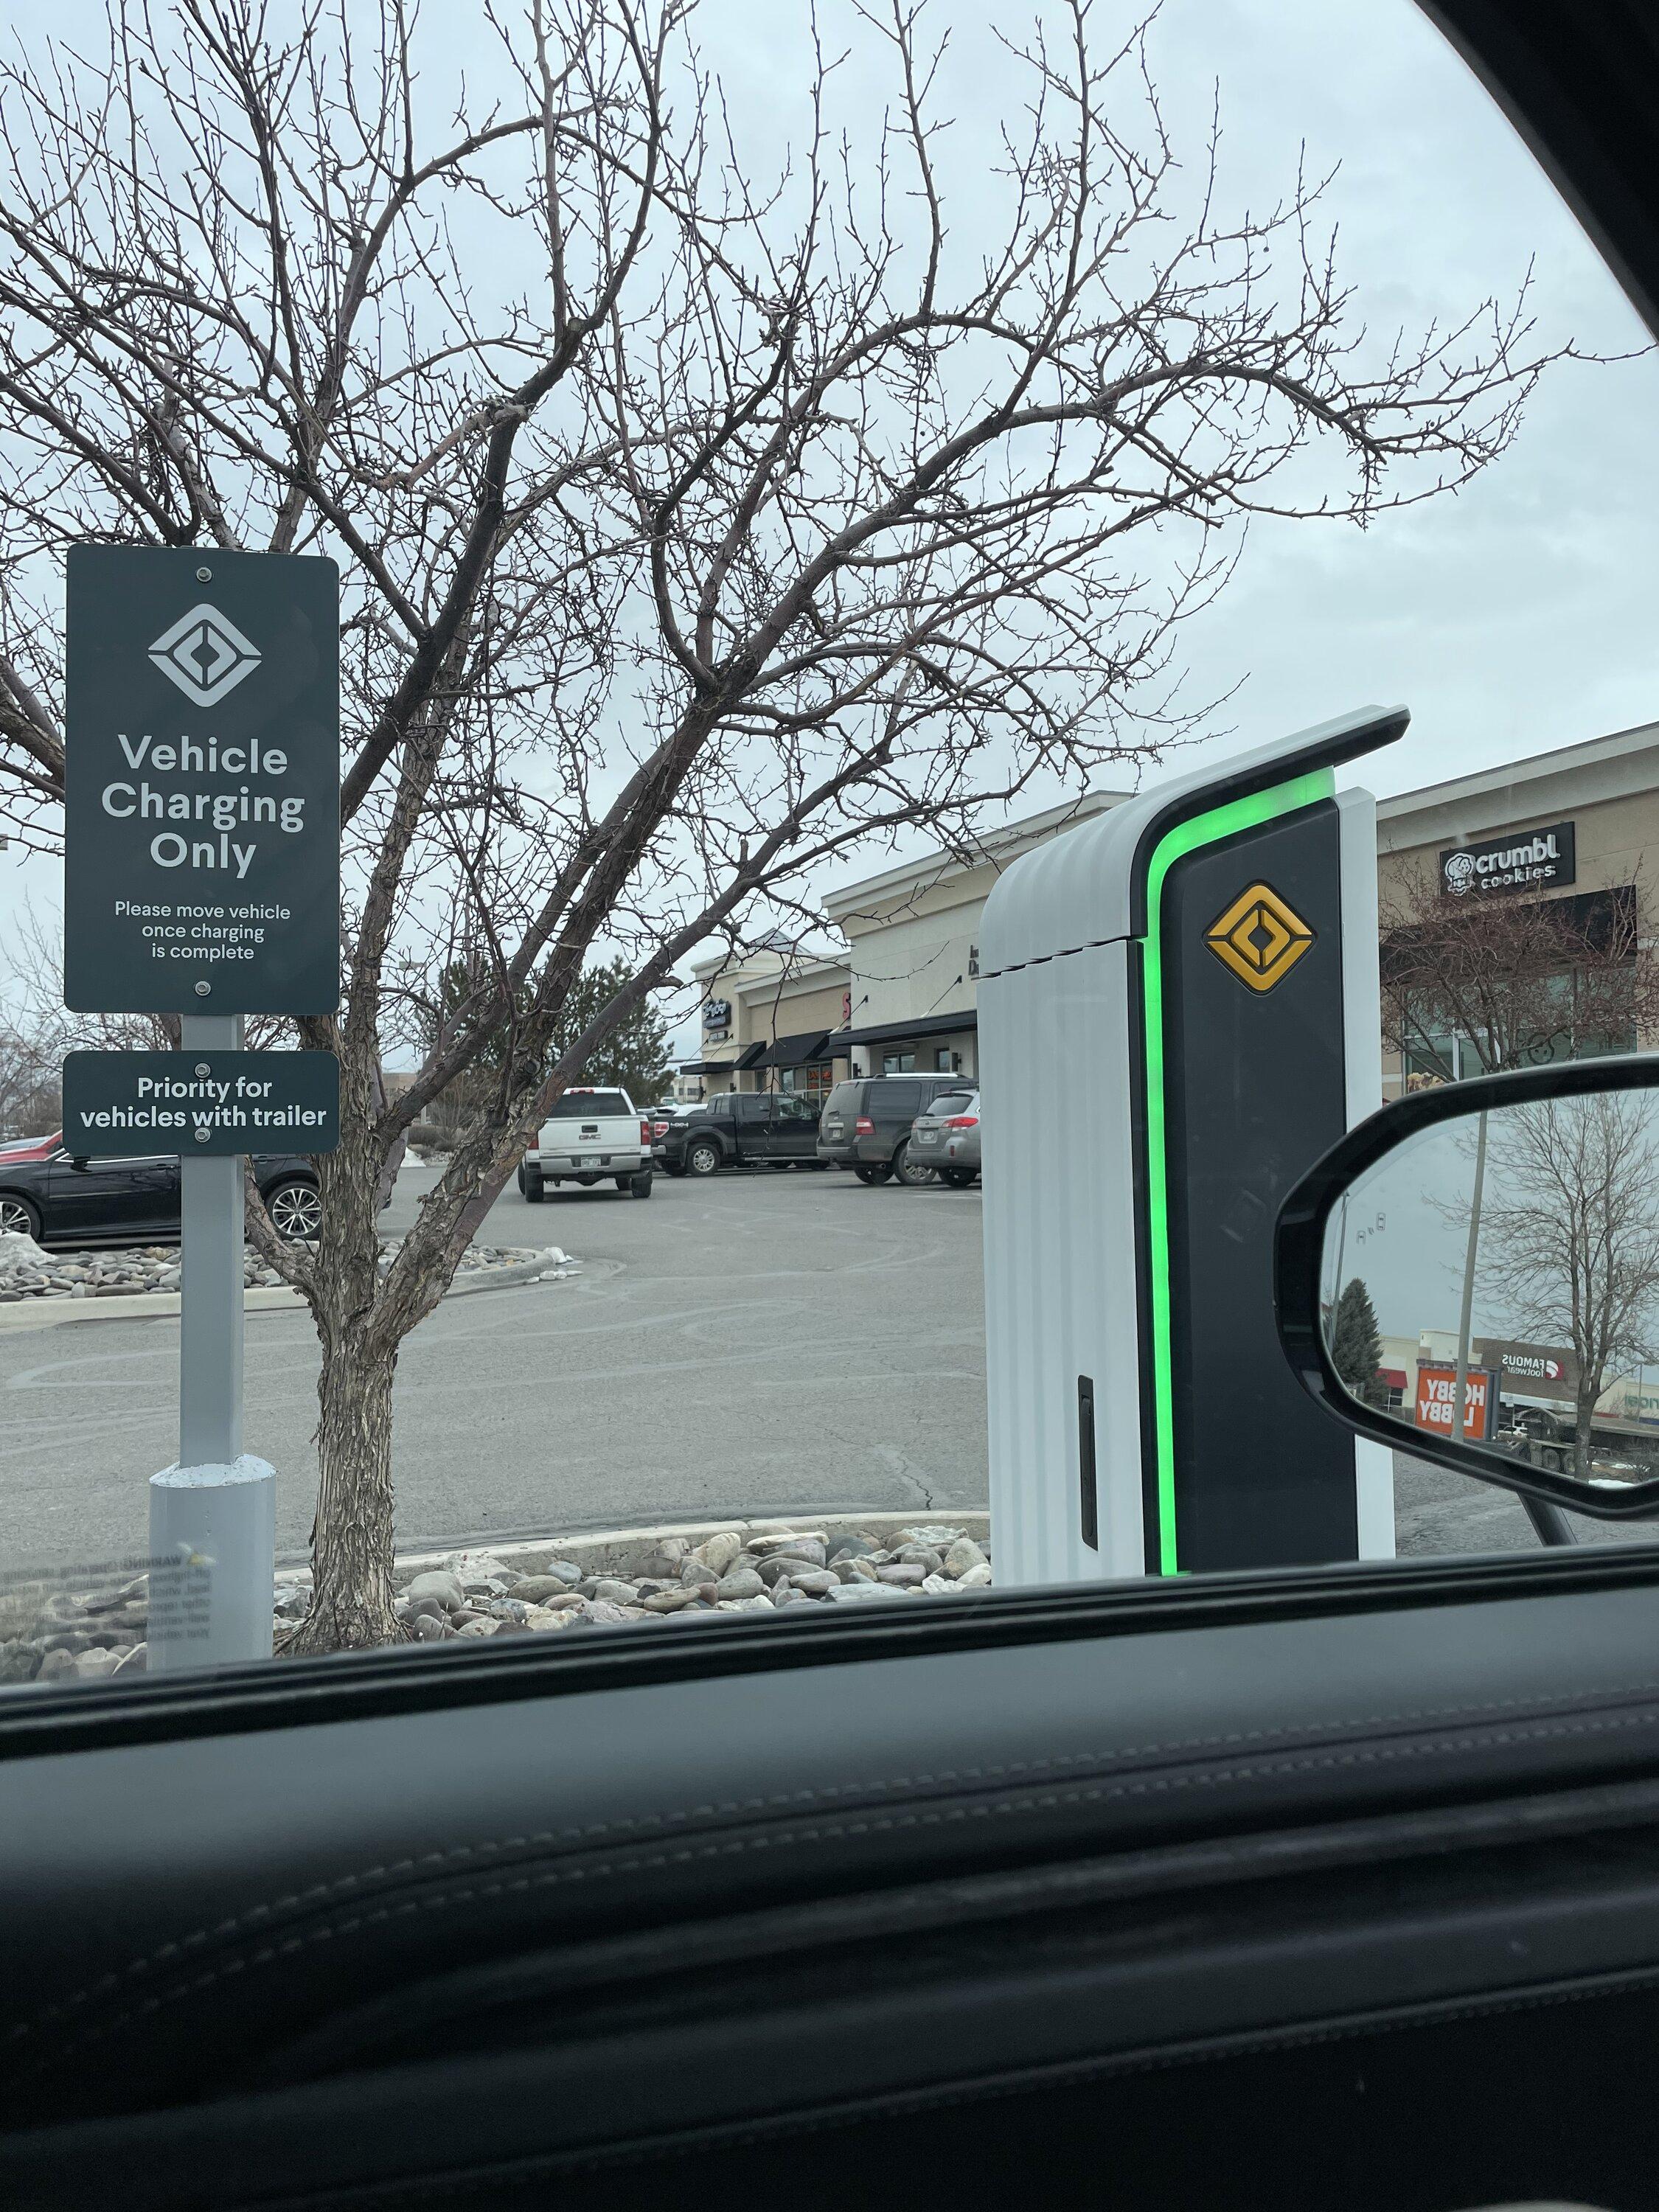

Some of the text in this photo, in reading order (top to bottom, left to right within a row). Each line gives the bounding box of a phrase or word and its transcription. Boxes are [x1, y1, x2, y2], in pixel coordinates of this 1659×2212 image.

[117, 734, 288, 775] Vehicle
[102, 782, 305, 833] Charging
[150, 832, 257, 879] Only
[1476, 834, 1557, 874] crumbl
[1481, 865, 1557, 889] cookies
[115, 900, 291, 919] Please move vehicle
[142, 923, 265, 943] once charging
[152, 942, 255, 962] is complete
[138, 1077, 273, 1103] Priority for
[80, 1105, 327, 1127] vehicles with trailer
